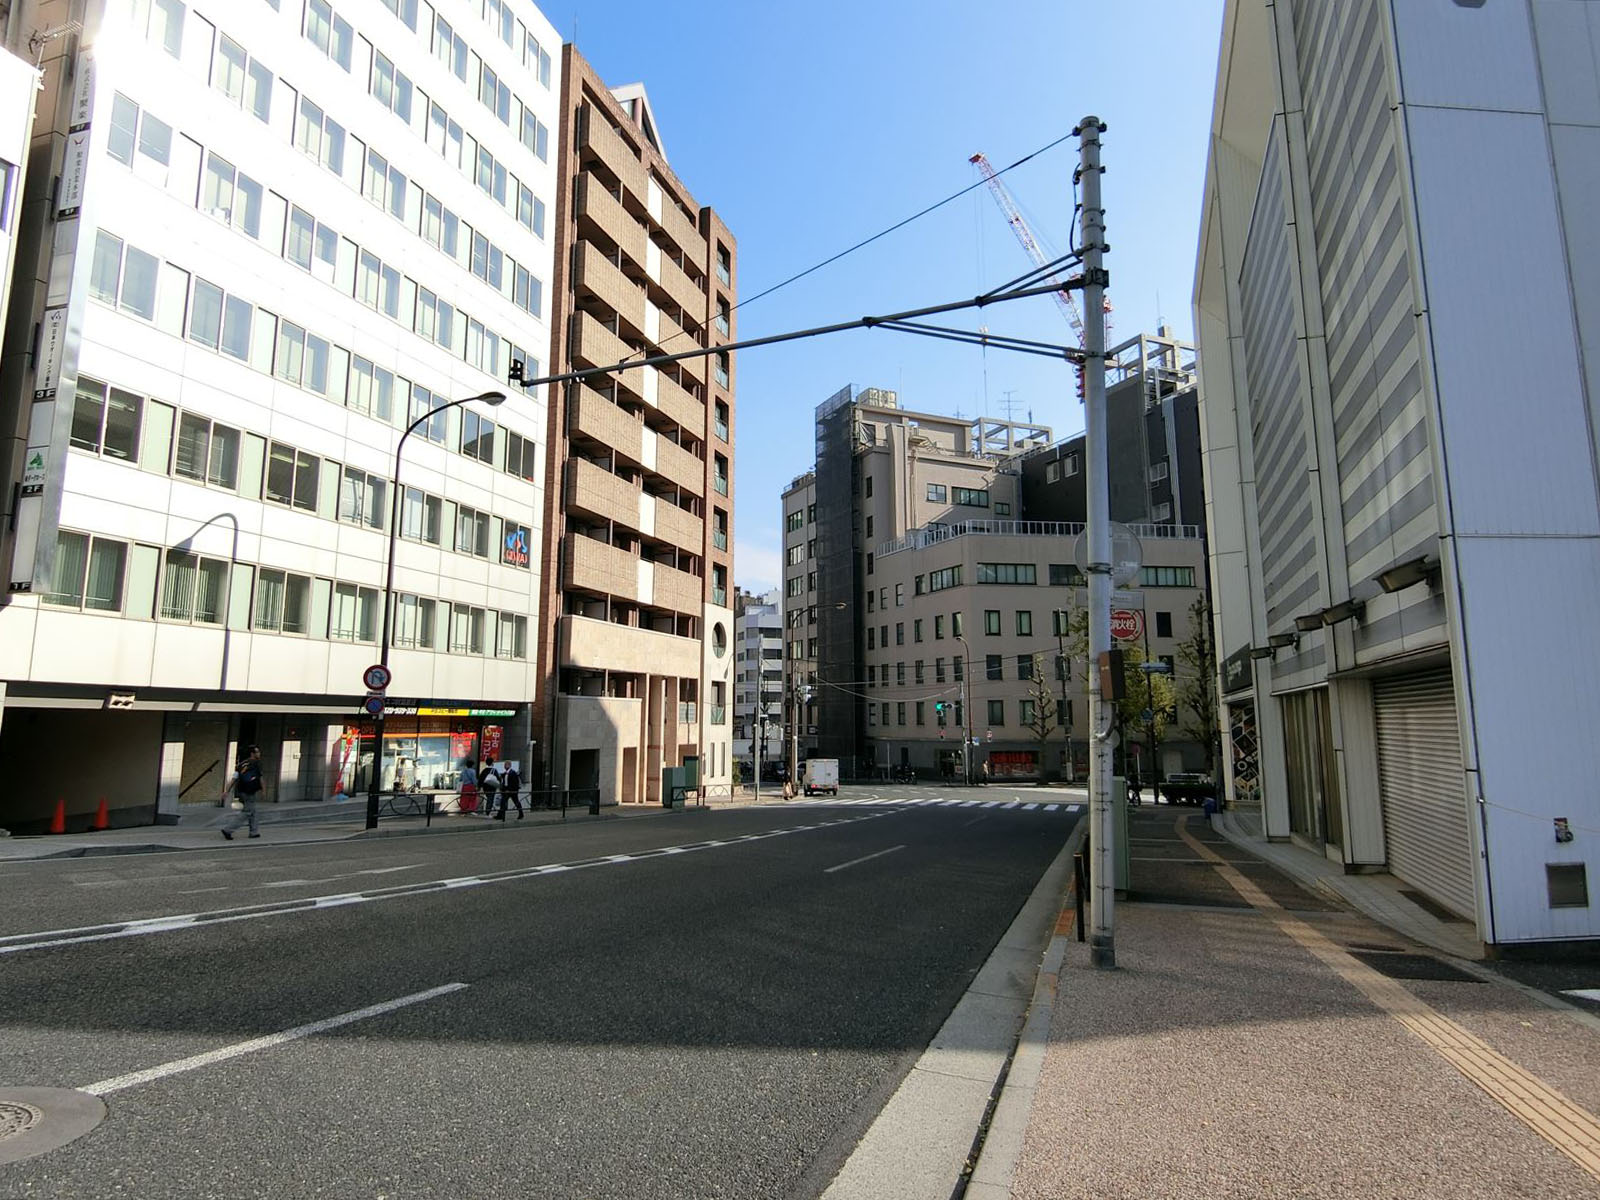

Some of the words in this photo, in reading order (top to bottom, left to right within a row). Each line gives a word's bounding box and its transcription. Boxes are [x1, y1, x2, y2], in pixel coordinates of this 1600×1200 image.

[36, 390, 55, 398] 3F
[26, 485, 41, 493] 2F
[1110, 618, 1135, 630] 消火栓
[491, 732, 500, 748] 中古
